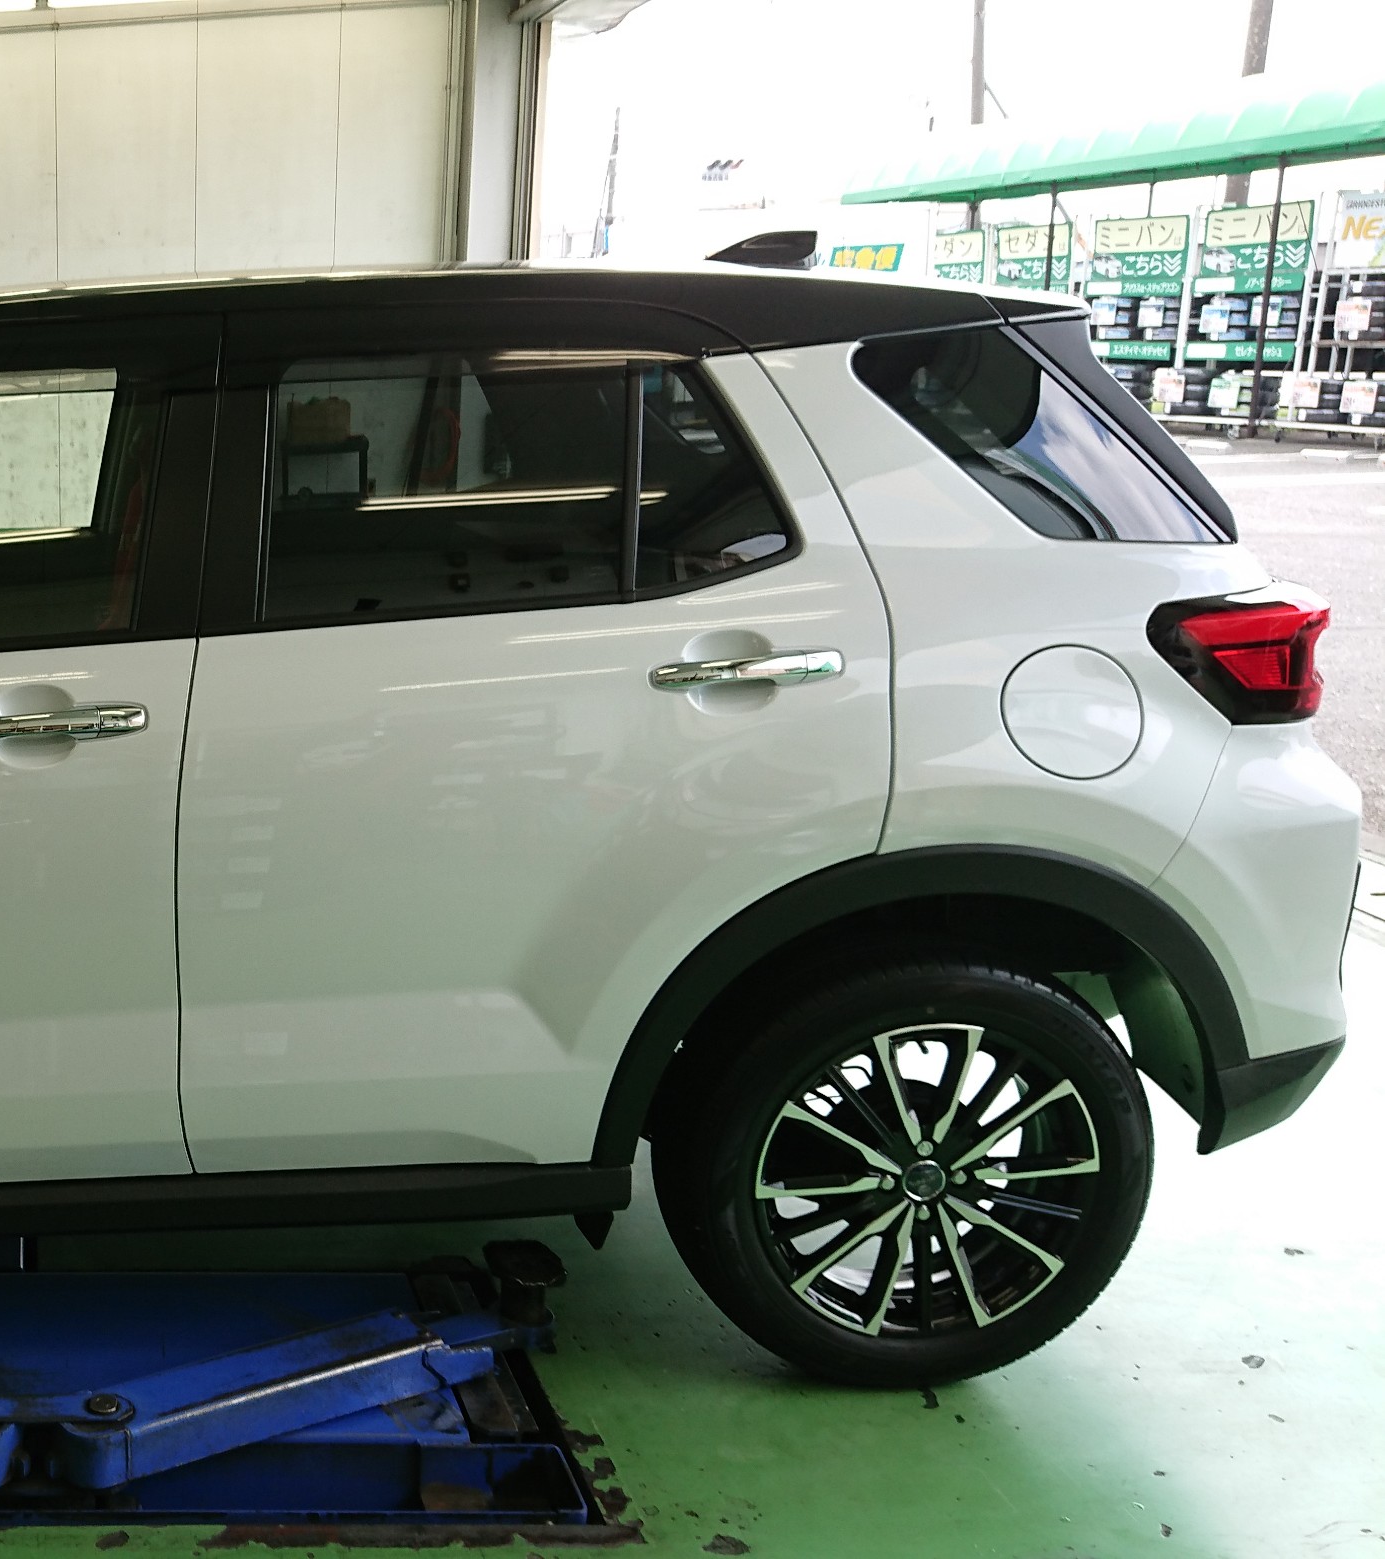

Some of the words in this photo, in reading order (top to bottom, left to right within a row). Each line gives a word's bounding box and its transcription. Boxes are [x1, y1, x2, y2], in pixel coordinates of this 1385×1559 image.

[1341, 215, 1385, 241] NE
[1122, 254, 1163, 276] こちら
[1237, 245, 1285, 270] こちら
[1021, 259, 1046, 280] こち
